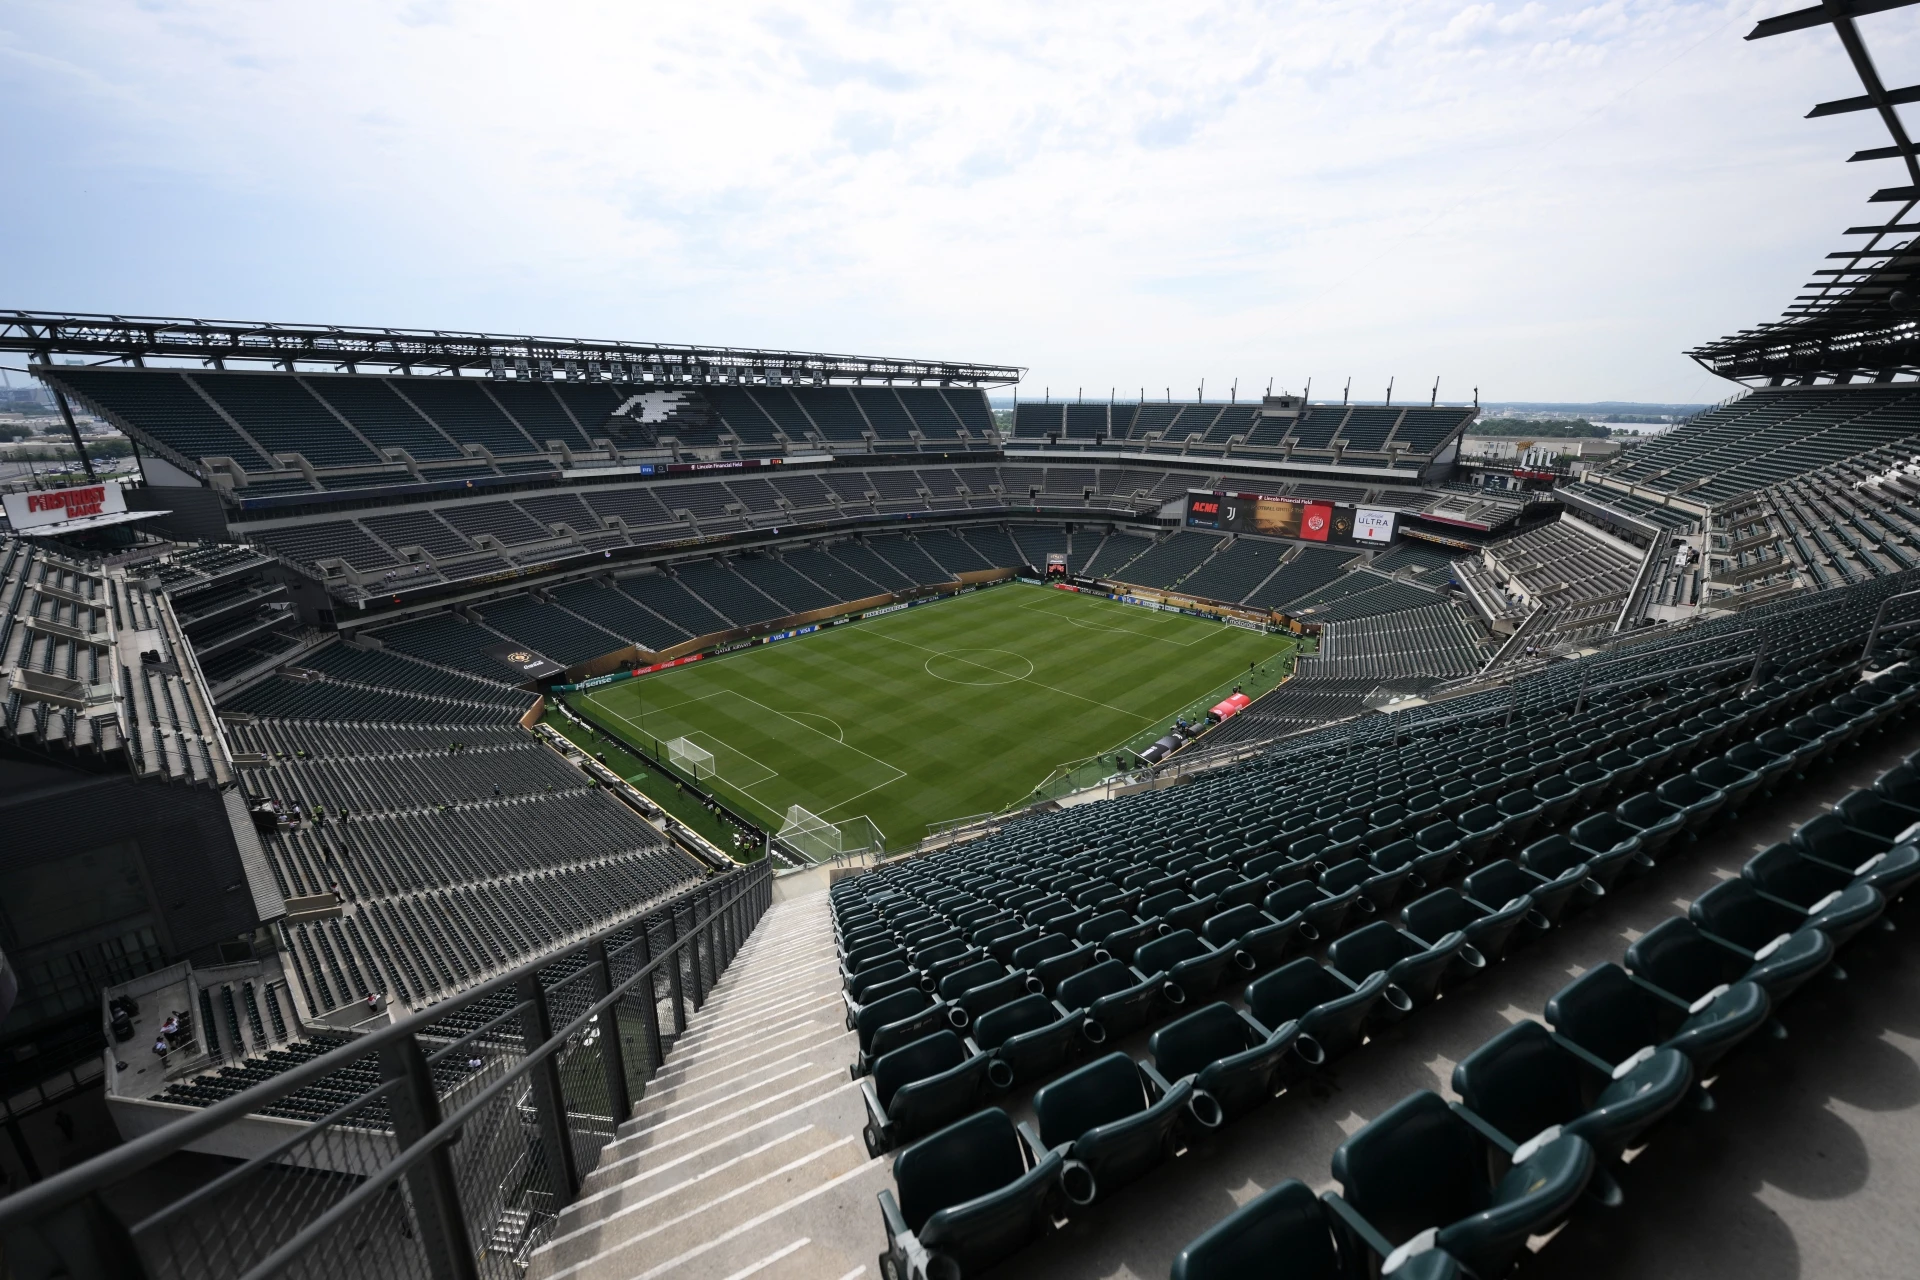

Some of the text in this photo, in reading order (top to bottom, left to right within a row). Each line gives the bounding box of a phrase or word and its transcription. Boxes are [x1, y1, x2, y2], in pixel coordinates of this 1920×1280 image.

[1280, 496, 1300, 504] Financial
[66, 503, 104, 518] BANK
[1192, 501, 1219, 513] ACME
[1358, 517, 1389, 526] ULTRA
[1229, 618, 1256, 630] motorola
[773, 633, 785, 641] VISA
[799, 627, 811, 635] VISA
[714, 642, 752, 655] QATAR AIRWAYS
[575, 676, 612, 690] Hisense
